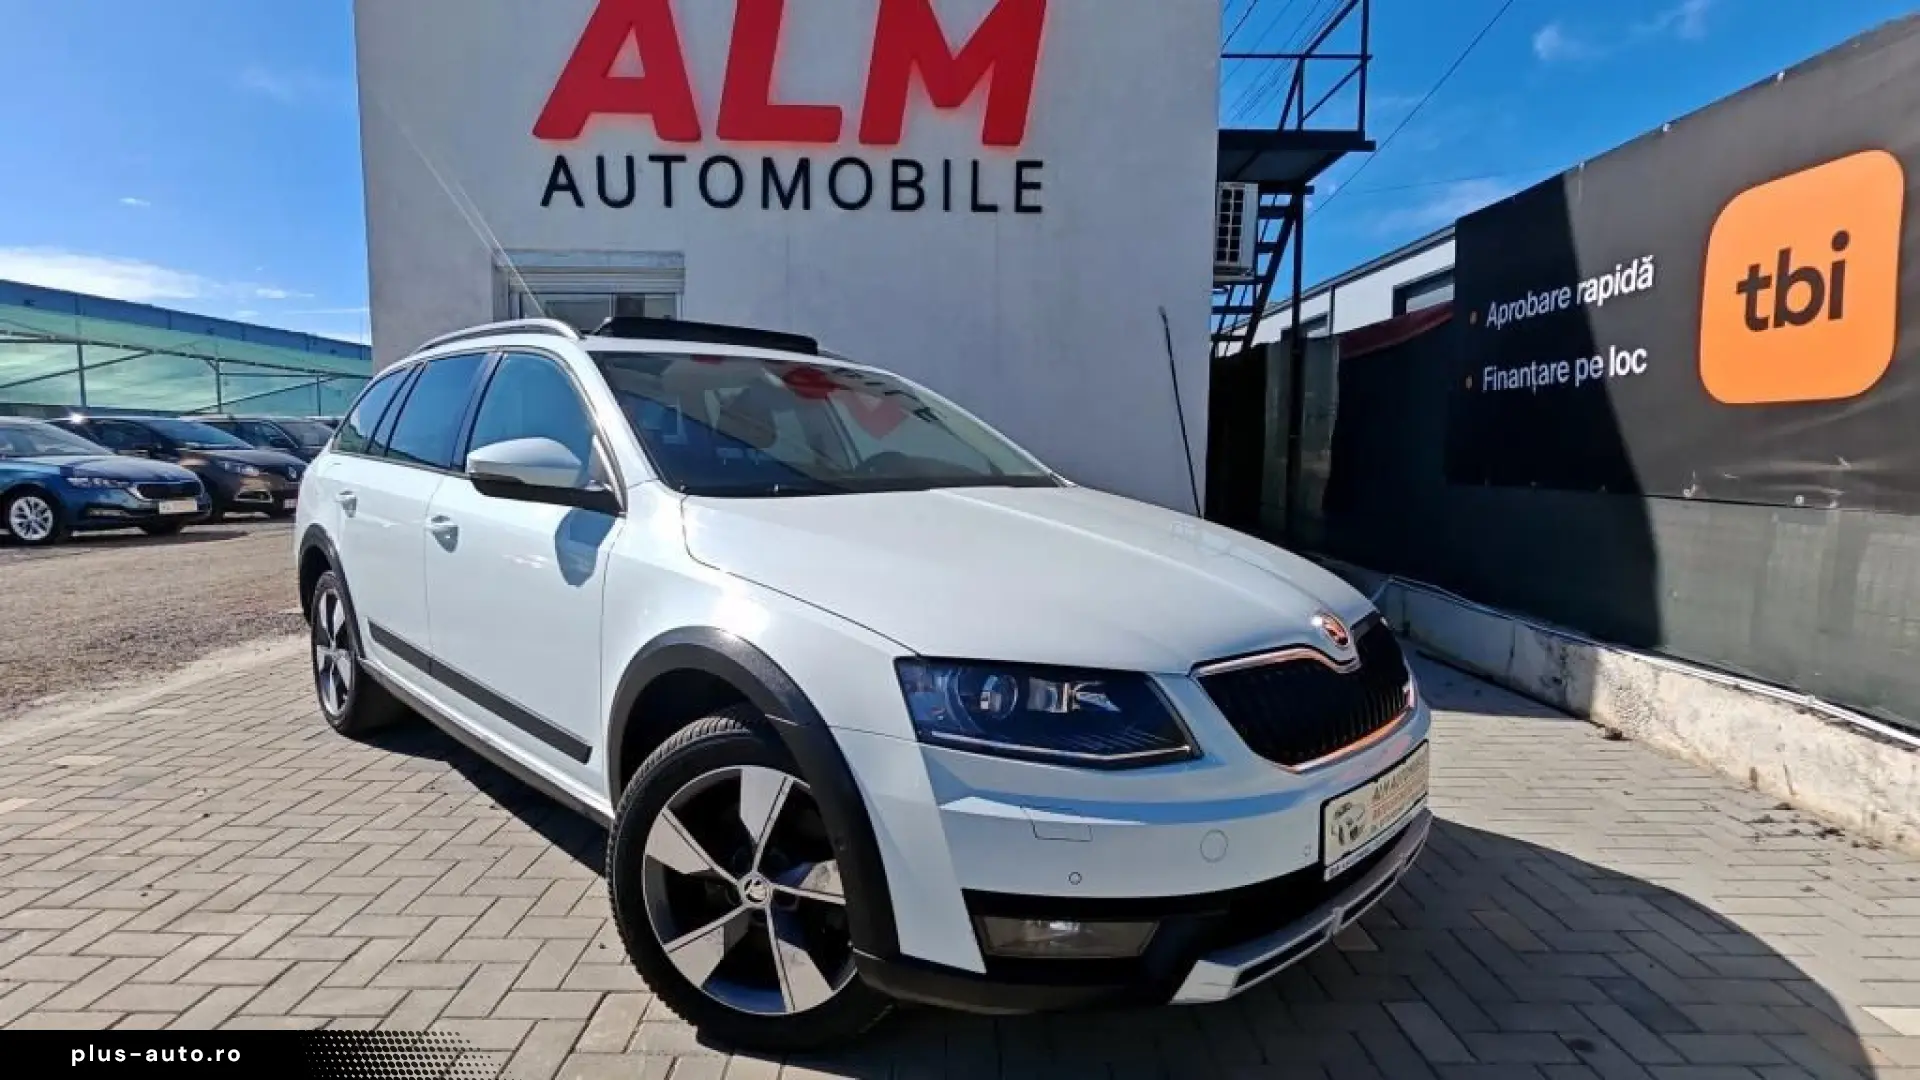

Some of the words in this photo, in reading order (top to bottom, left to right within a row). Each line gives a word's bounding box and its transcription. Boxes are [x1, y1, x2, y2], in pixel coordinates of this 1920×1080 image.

[532, 0, 1047, 147] ALM
[541, 154, 1044, 213] AUTOMOBILE
[1486, 286, 1572, 330] Aprobare
[1576, 255, 1655, 307] rapidă
[1736, 230, 1851, 333] tbi
[1574, 353, 1605, 387] pe
[1608, 344, 1648, 376] loc
